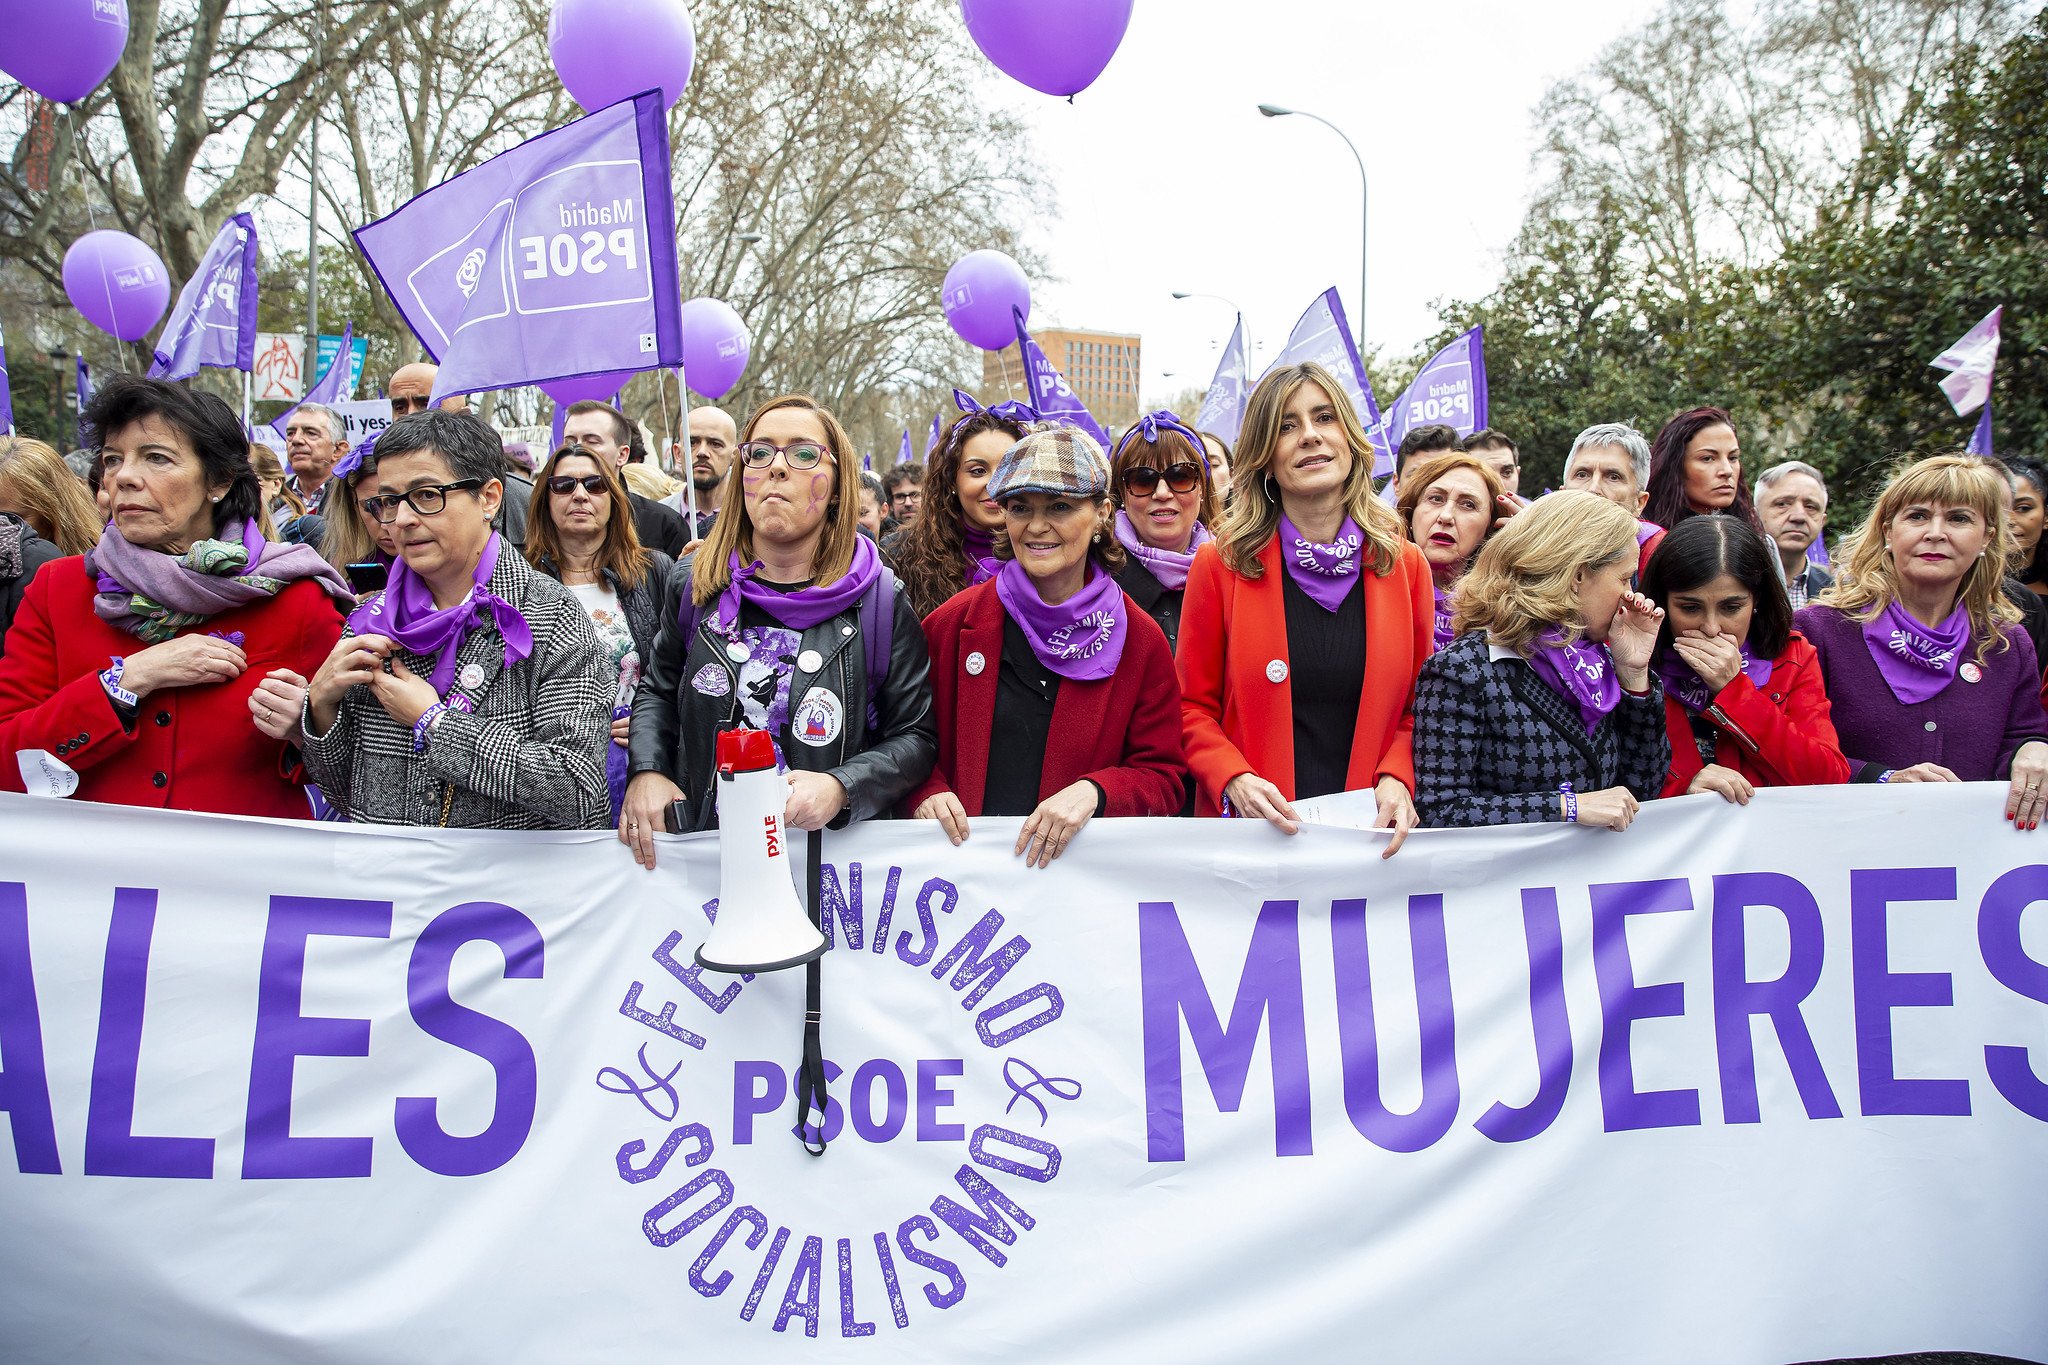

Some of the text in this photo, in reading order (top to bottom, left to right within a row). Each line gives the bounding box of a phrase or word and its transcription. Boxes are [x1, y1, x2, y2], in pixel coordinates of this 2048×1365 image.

[818, 703, 833, 717] TODAS
[820, 699, 835, 712] MADRID
[619, 862, 1065, 1050] FENISMO
[732, 1058, 965, 1145] PSOE
[615, 1121, 1063, 1339] SOCIALISMO
